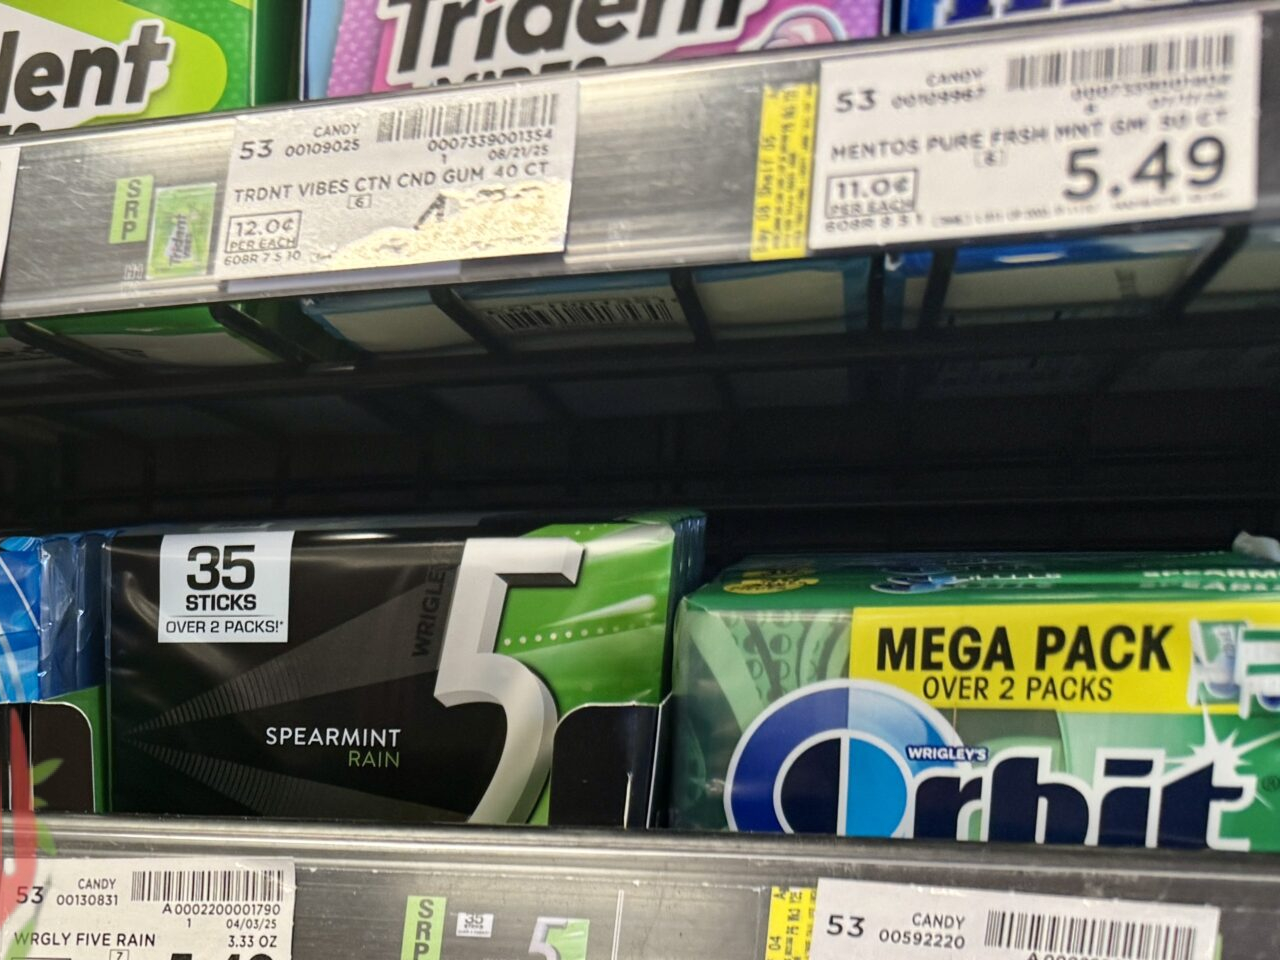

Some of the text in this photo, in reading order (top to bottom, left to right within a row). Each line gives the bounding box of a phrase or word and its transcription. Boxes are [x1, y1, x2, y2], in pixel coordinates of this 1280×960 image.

[1063, 137, 1226, 200] 5.49
[187, 545, 255, 590] 35
[186, 594, 257, 611] STICKS
[166, 620, 207, 634] OVER
[210, 620, 220, 633] 2
[876, 625, 1172, 671] MEGA PACK
[434, 538, 584, 824] 5
[922, 676, 1112, 701] OVER 2 PACKS
[266, 727, 401, 748] SPEARMINT
[348, 750, 400, 768] RAIN
[907, 746, 988, 761] WRIGLEY'S
[78, 878, 116, 890] CANDY
[57, 894, 118, 906] 00130831
[14, 932, 155, 947] WRGLY FIVE RAIN
